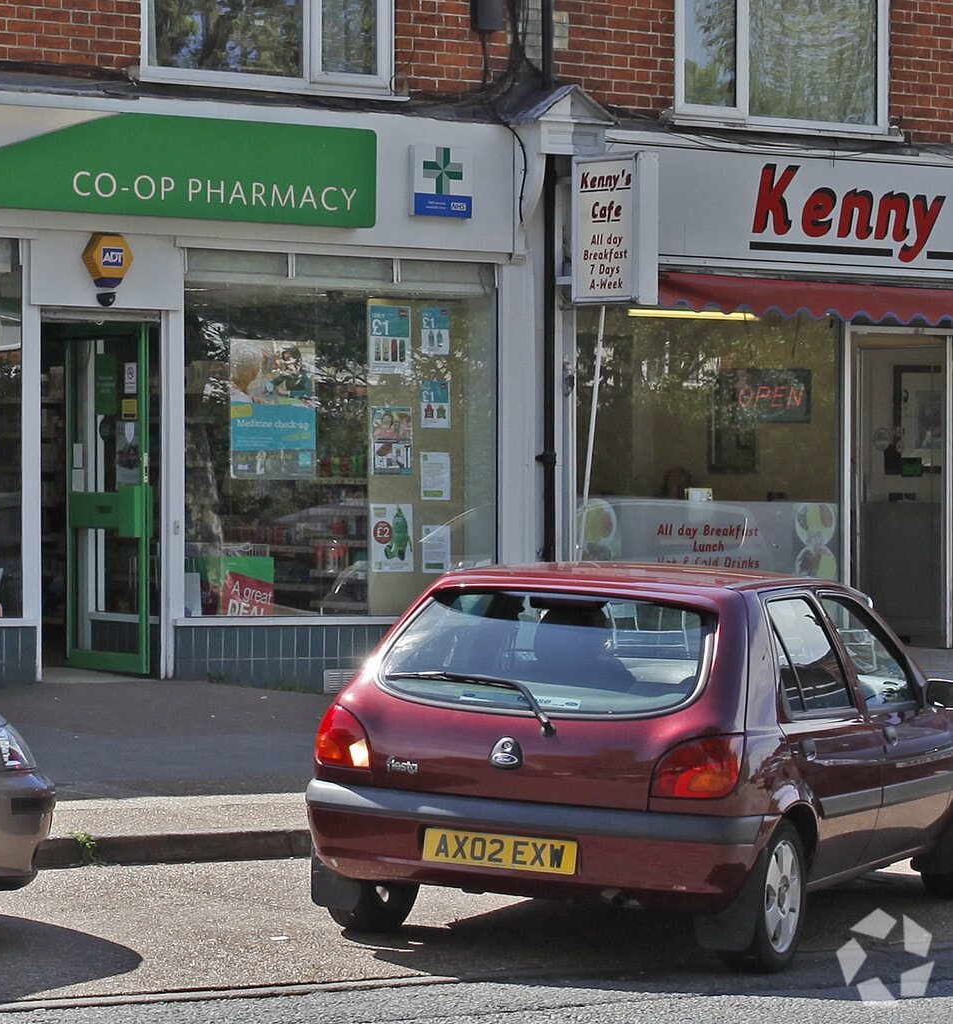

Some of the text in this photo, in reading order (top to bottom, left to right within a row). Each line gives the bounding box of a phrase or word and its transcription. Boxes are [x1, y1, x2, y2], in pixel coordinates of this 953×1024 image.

[580, 169, 632, 192] Kenny's
[72, 170, 358, 212] CO-OP PHARMACY
[451, 201, 467, 212] NHS
[591, 200, 623, 223] Cafe
[751, 162, 948, 263] Kenny
[590, 233, 624, 247] All day
[102, 251, 124, 263] ADT
[583, 248, 628, 263] Breakfast
[590, 263, 621, 278] 7 Days
[589, 278, 624, 290] A-Week
[371, 318, 389, 336] £1
[422, 316, 435, 329] £1
[422, 390, 434, 402] £1
[738, 385, 805, 408] OPEN
[237, 419, 273, 428] Medicine
[376, 526, 390, 538] £2
[657, 524, 673, 536] All
[677, 524, 698, 539] day
[693, 540, 725, 552] Lunch
[724, 556, 760, 569] Drinks
[231, 581, 273, 605] A great
[434, 833, 565, 869] AX02 EXW
